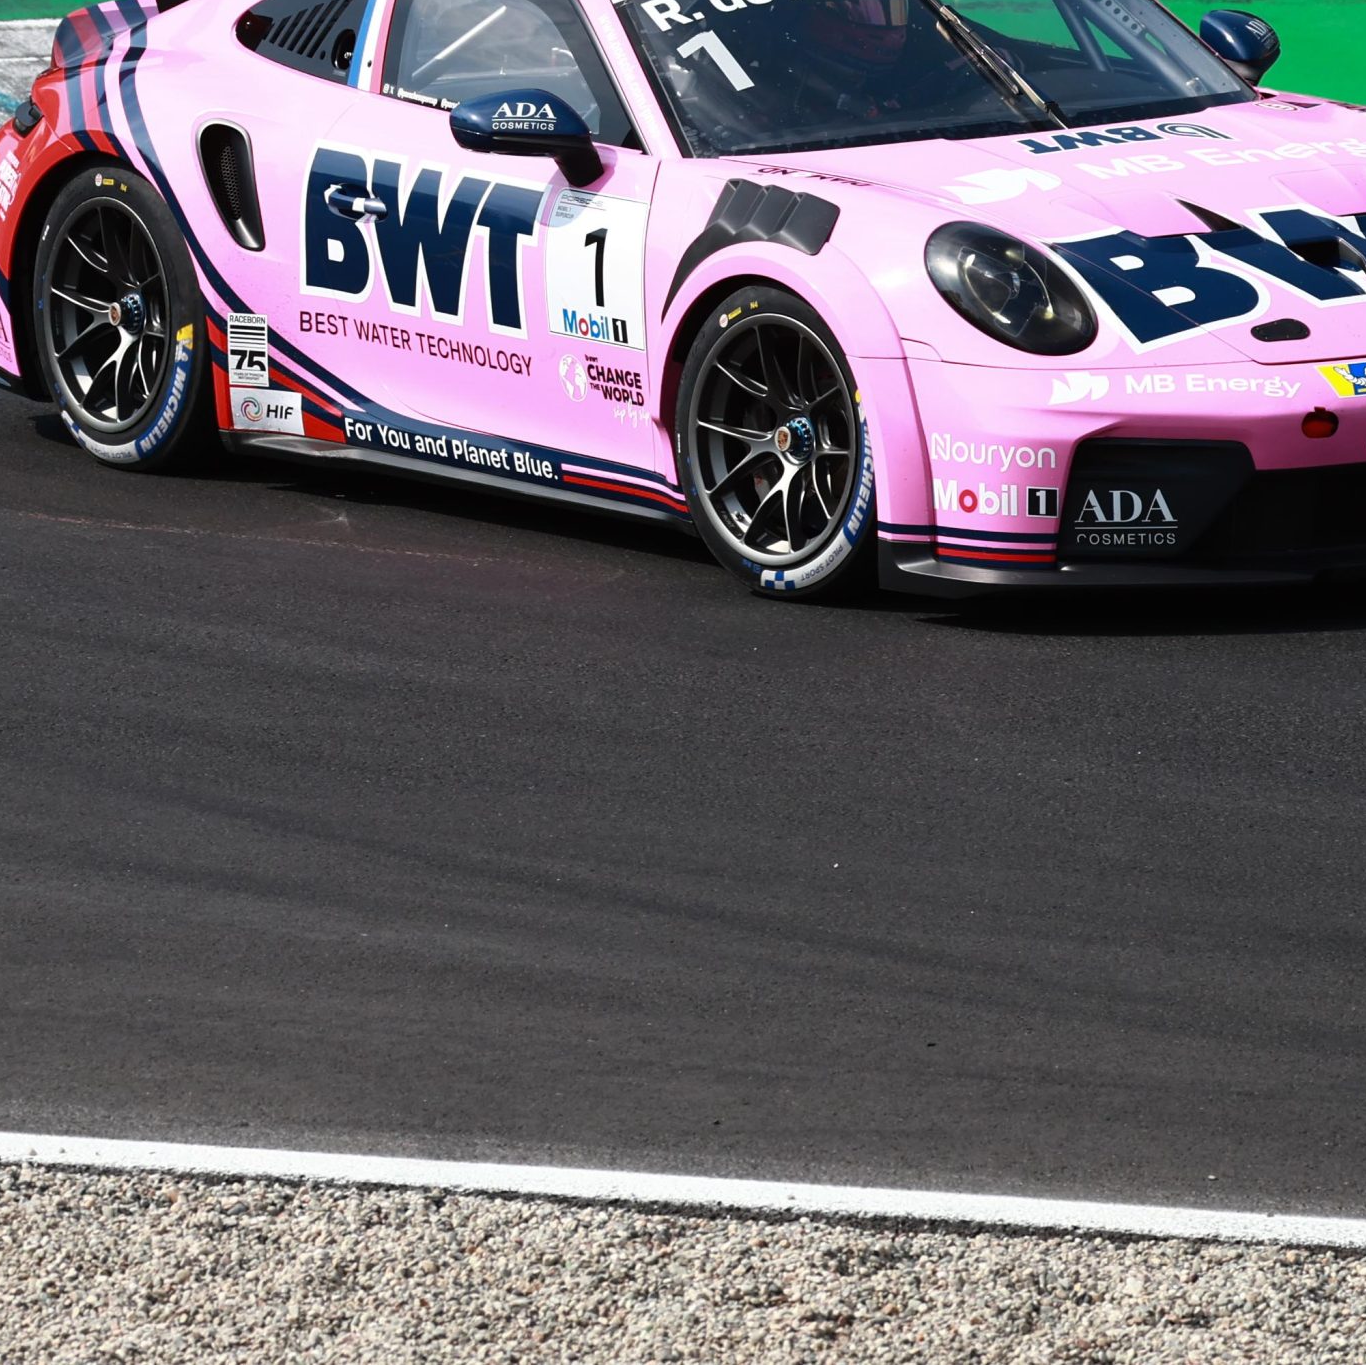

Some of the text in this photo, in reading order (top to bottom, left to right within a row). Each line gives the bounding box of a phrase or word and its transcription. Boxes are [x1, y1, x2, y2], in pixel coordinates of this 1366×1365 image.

[677, 29, 755, 92] 1
[492, 102, 557, 120] ADA
[492, 121, 555, 131] COSMETICS
[1017, 125, 1157, 155] BWT
[1076, 153, 1186, 180] MB
[302, 143, 549, 334] BWT
[584, 227, 609, 308] 1
[229, 315, 266, 325] RACEBORN
[563, 308, 629, 345] Mobil 1
[230, 349, 266, 372] 75
[299, 311, 532, 377] BEST WATER TECHNOLOGY
[587, 364, 642, 390] CHANGE
[1125, 373, 1302, 399] MB Energy
[140, 366, 187, 454] MICHELIN
[590, 382, 645, 407] THE WORLD
[266, 404, 294, 420] HIF
[344, 416, 560, 481] For You and Planet Blue.
[931, 432, 1057, 474] Nouryon
[933, 478, 1059, 519] Mobil 1
[1075, 488, 1178, 524] ADA
[1076, 532, 1177, 546] COSMETICS
[800, 545, 844, 582] PILOT SPORT
